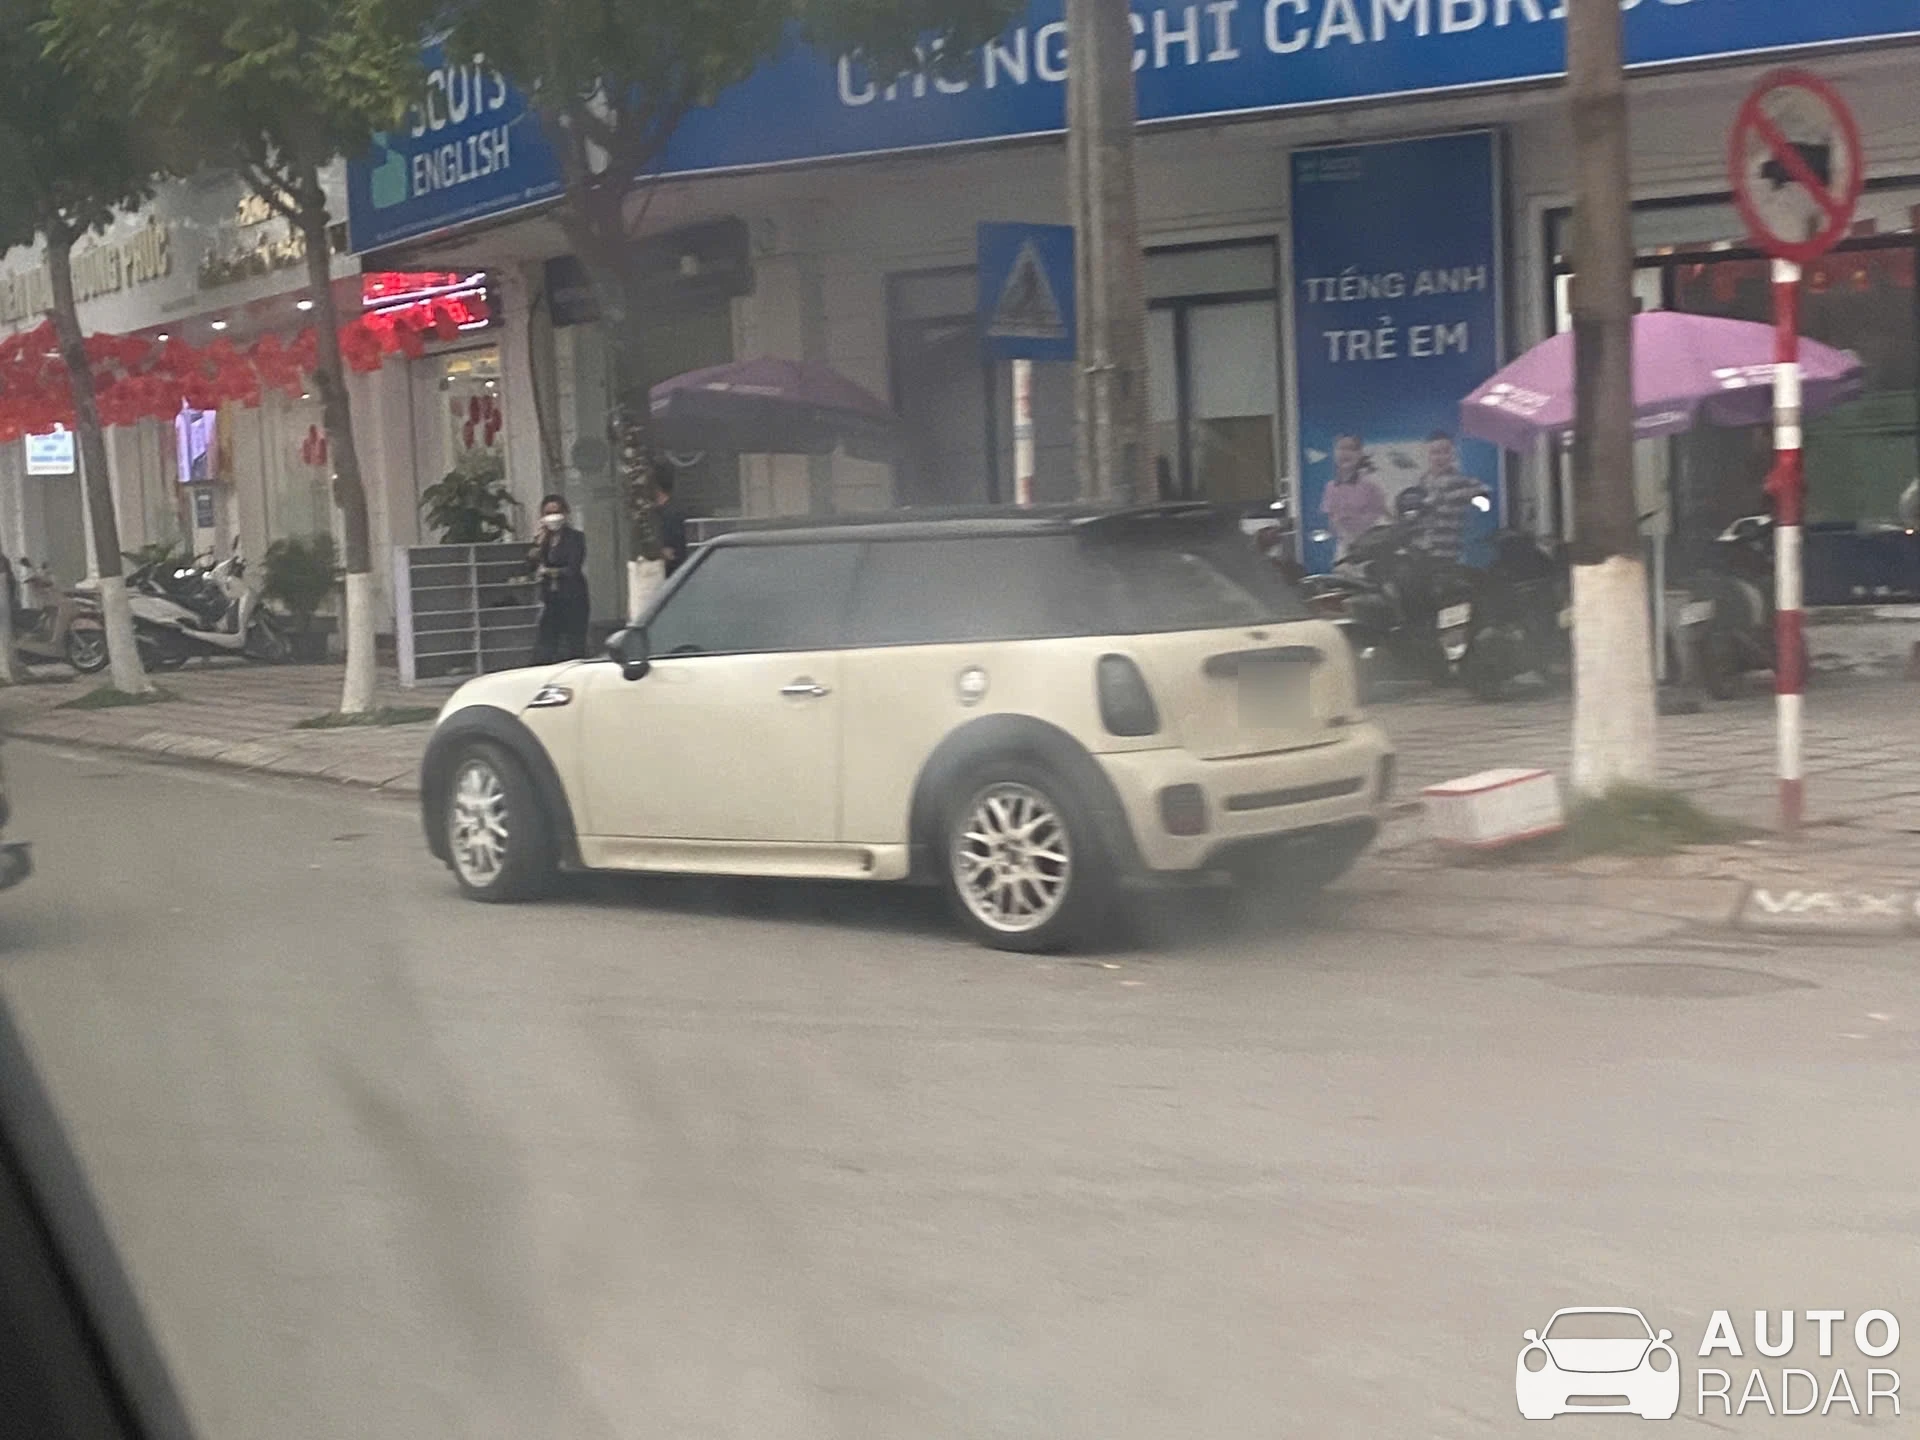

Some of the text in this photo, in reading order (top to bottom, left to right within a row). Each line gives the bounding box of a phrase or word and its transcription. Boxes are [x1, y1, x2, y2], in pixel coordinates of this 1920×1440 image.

[412, 125, 511, 197] ENGLISH
[1412, 265, 1487, 296] ANH
[1322, 314, 1468, 363] TRẺ EM
